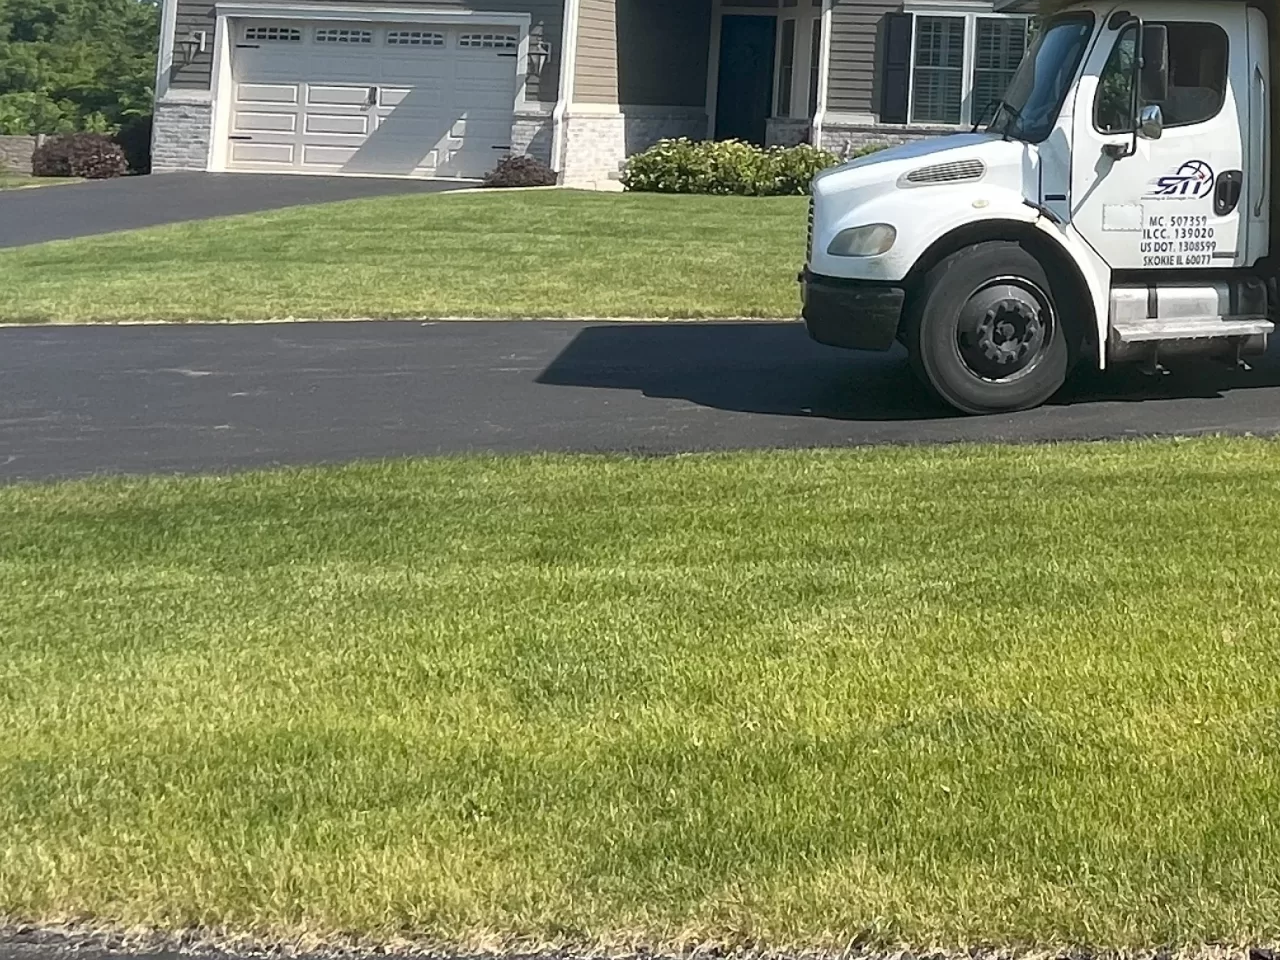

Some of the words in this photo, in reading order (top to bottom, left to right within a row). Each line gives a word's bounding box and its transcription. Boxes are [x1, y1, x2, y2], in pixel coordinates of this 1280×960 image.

[1170, 215, 1207, 227] 507359
[1175, 227, 1214, 239] 139020
[1140, 241, 1152, 252] US
[1179, 241, 1217, 252] 1308599
[1143, 255, 1174, 266] SKOKIE
[1176, 255, 1183, 266] IL
[1185, 254, 1211, 265] 60077
